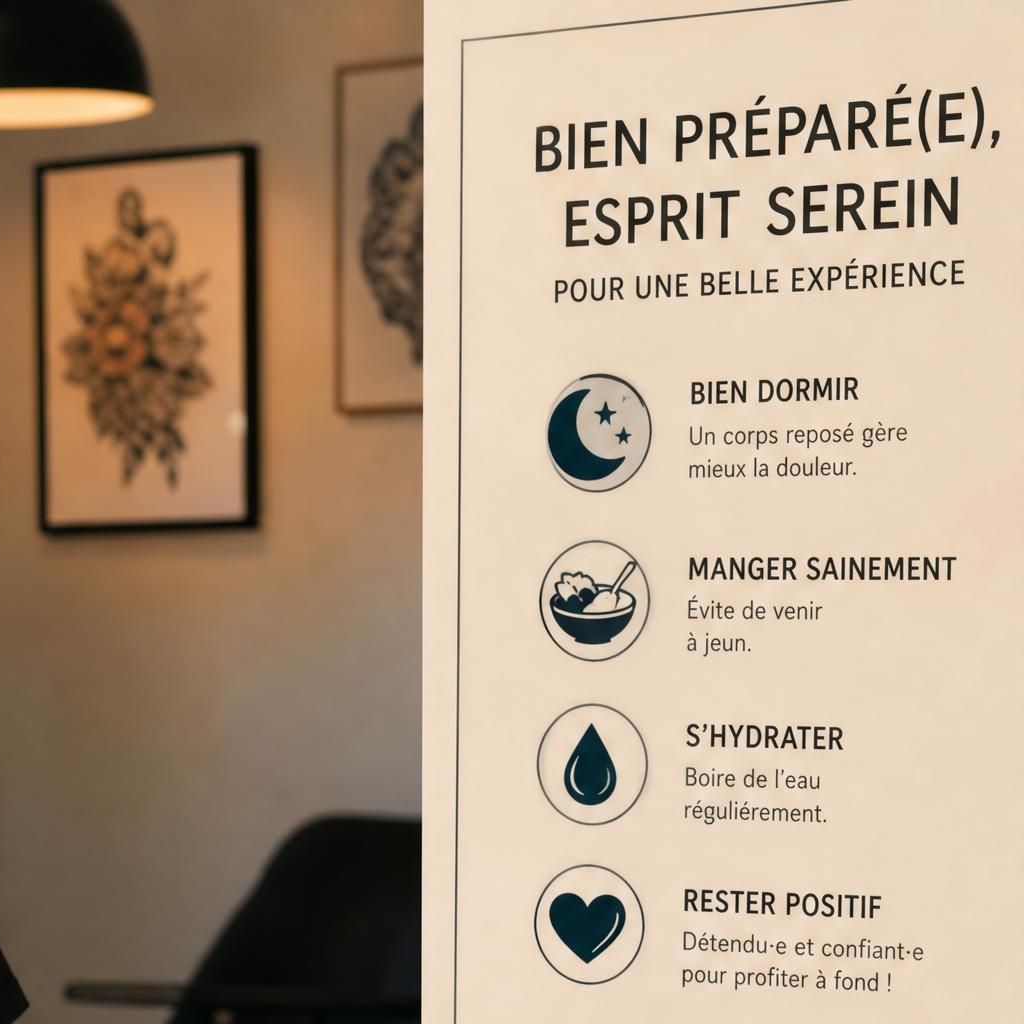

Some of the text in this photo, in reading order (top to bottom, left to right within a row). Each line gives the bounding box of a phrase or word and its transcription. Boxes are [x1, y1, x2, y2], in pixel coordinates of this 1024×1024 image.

[535, 82, 1001, 173] BIEN PRÉPARÉ(E),
[565, 175, 959, 248] ESPRIT SEREIN
[554, 257, 965, 304] POUR UNE BELLE EXPÉRIENCE
[690, 376, 859, 405] BIEN DORMIR
[689, 421, 908, 451] Un corps reposé gère
[688, 455, 857, 479] mieux la douleur.
[688, 556, 958, 581] MANGER SAINEMENT
[687, 597, 824, 621] Évite de venir
[686, 631, 752, 658] à jeun.
[686, 723, 844, 751] S’HYDRATER
[685, 766, 821, 790] Boire de l’eau
[684, 799, 827, 826] réguliérement.
[683, 888, 882, 919] RESTER POSITIF
[794, 938, 815, 957] et
[682, 966, 892, 993] pour profiter à fond !
